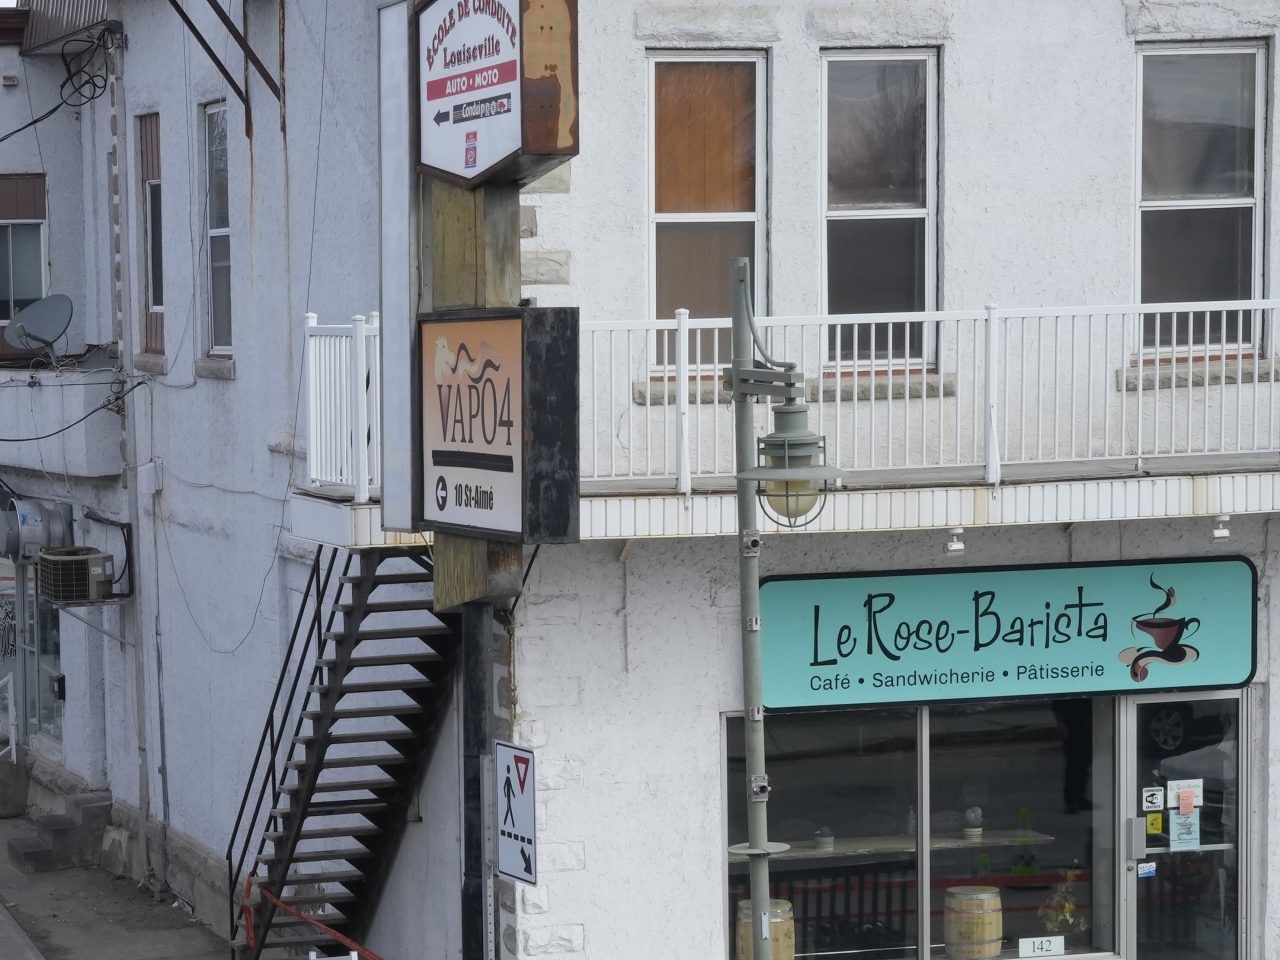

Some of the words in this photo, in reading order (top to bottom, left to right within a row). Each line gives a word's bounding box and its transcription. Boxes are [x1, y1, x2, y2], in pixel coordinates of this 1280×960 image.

[457, 0, 470, 20] DE
[472, 0, 518, 49] CONDUITE
[442, 34, 501, 69] Louiseville
[445, 75, 468, 95] AUTO
[474, 68, 499, 88] MOTO
[436, 376, 514, 446] VAPO4
[454, 483, 463, 507] 10
[464, 485, 494, 511] St-Aimé
[809, 603, 857, 667] Le
[863, 585, 1109, 663] Rose-Barista
[809, 671, 851, 692] Café
[872, 666, 995, 689] Sandwicherie
[1016, 661, 1105, 683] Pâtisserie
[1031, 939, 1052, 953] 142
